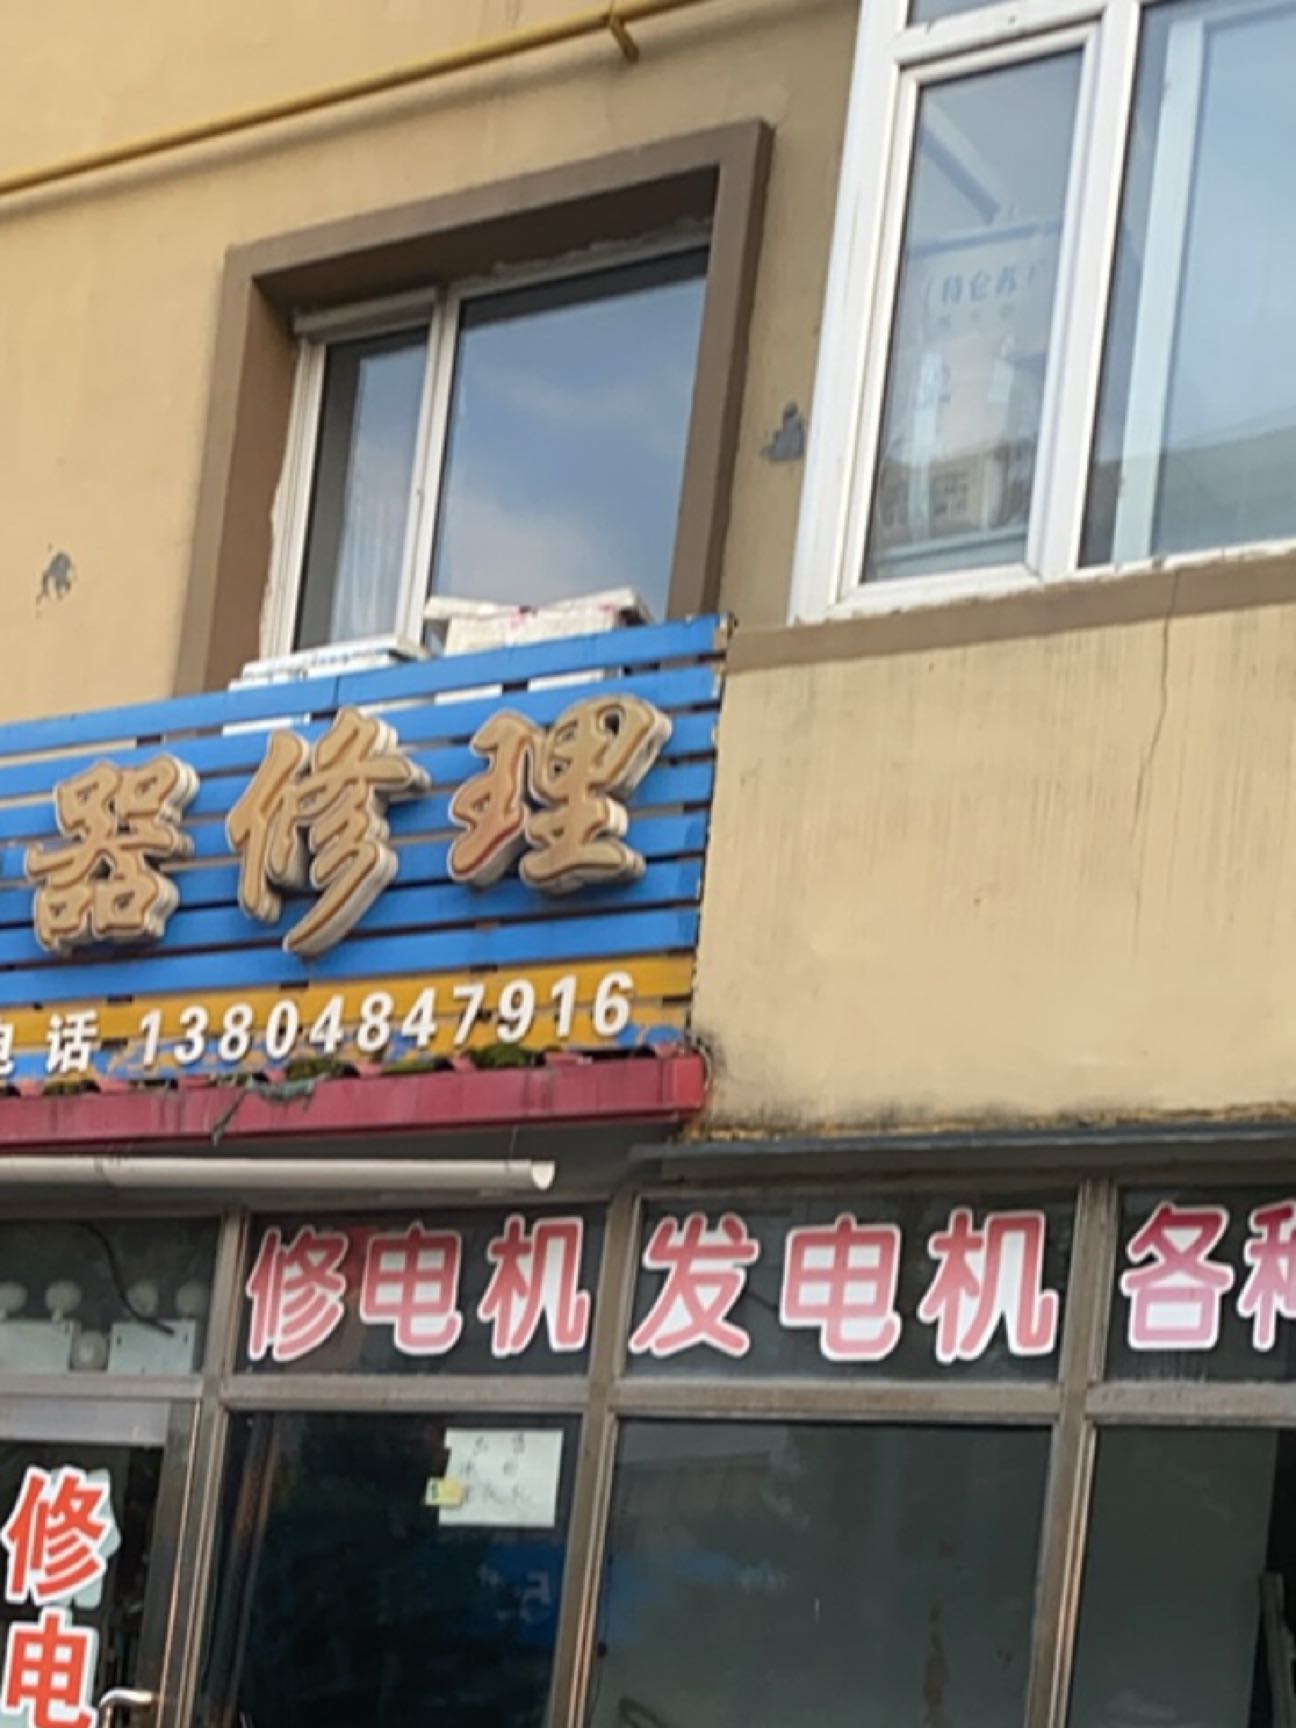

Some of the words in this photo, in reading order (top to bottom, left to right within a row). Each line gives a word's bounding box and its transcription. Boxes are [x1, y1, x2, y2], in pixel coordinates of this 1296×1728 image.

[138, 970, 634, 1071] 13804847916
[246, 1214, 589, 1362] 修电机
[629, 1208, 1060, 1362] 发电机
